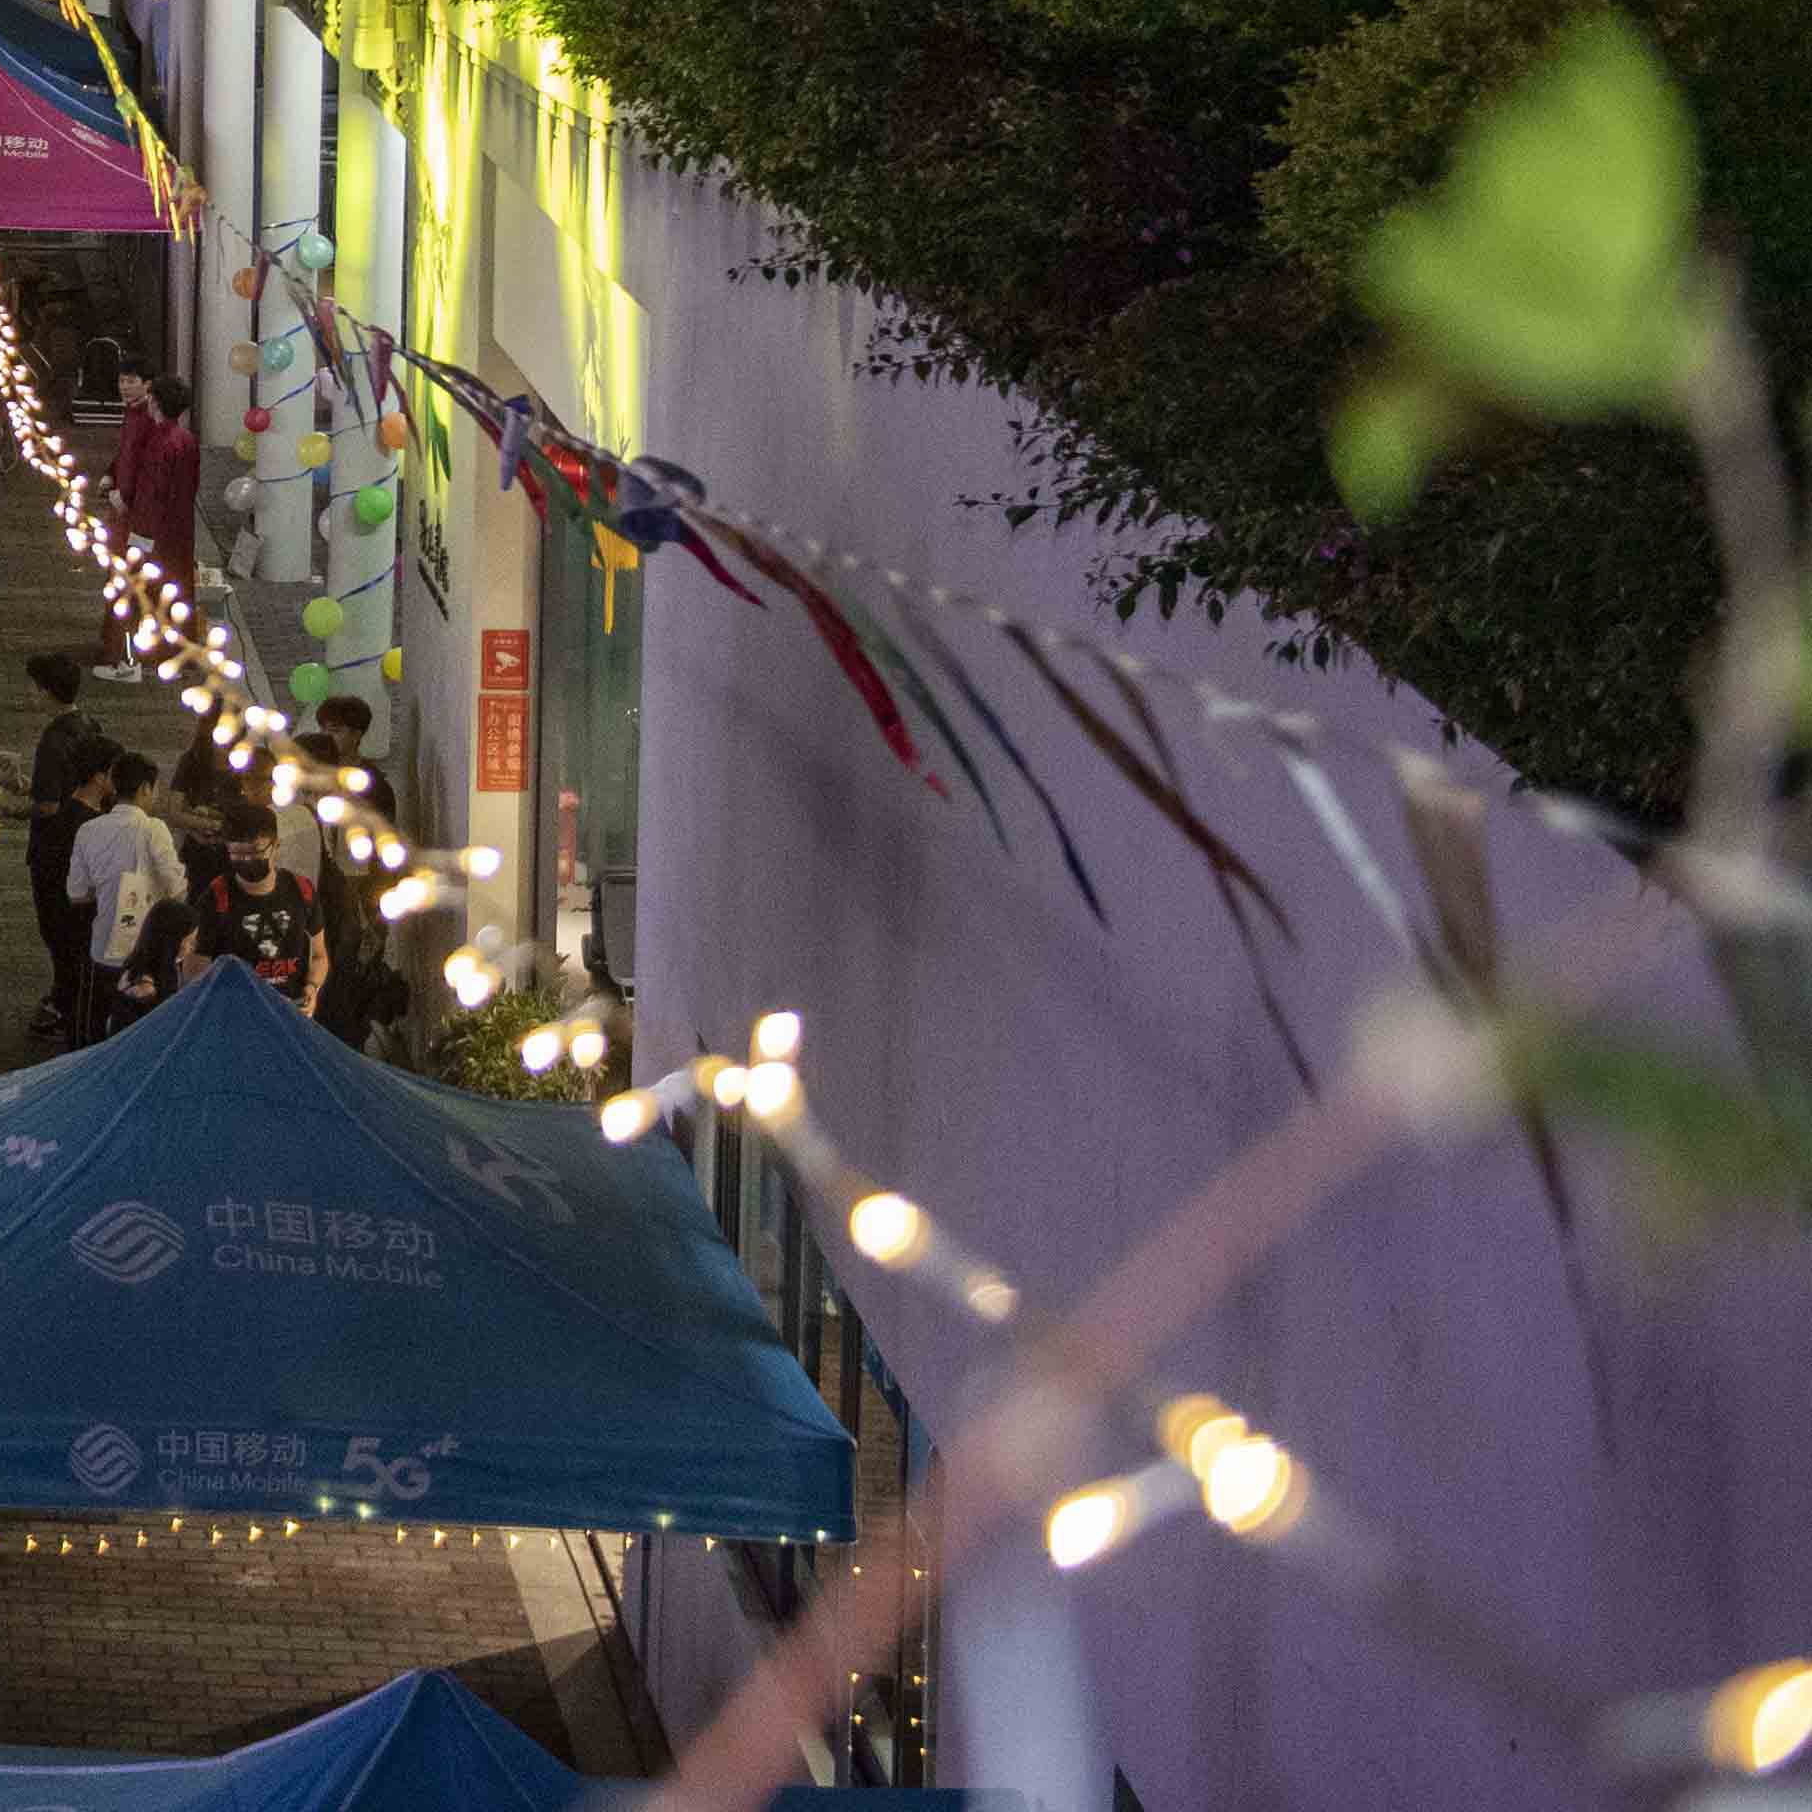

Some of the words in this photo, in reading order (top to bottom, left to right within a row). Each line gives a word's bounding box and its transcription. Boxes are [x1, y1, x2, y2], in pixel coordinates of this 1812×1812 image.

[206, 1197, 436, 1259] 中国移动
[213, 1243, 317, 1278] China
[327, 1253, 443, 1289] Mobile
[158, 1429, 306, 1468] 中国移动
[158, 1468, 224, 1491] China
[231, 1470, 308, 1494] Mobile
